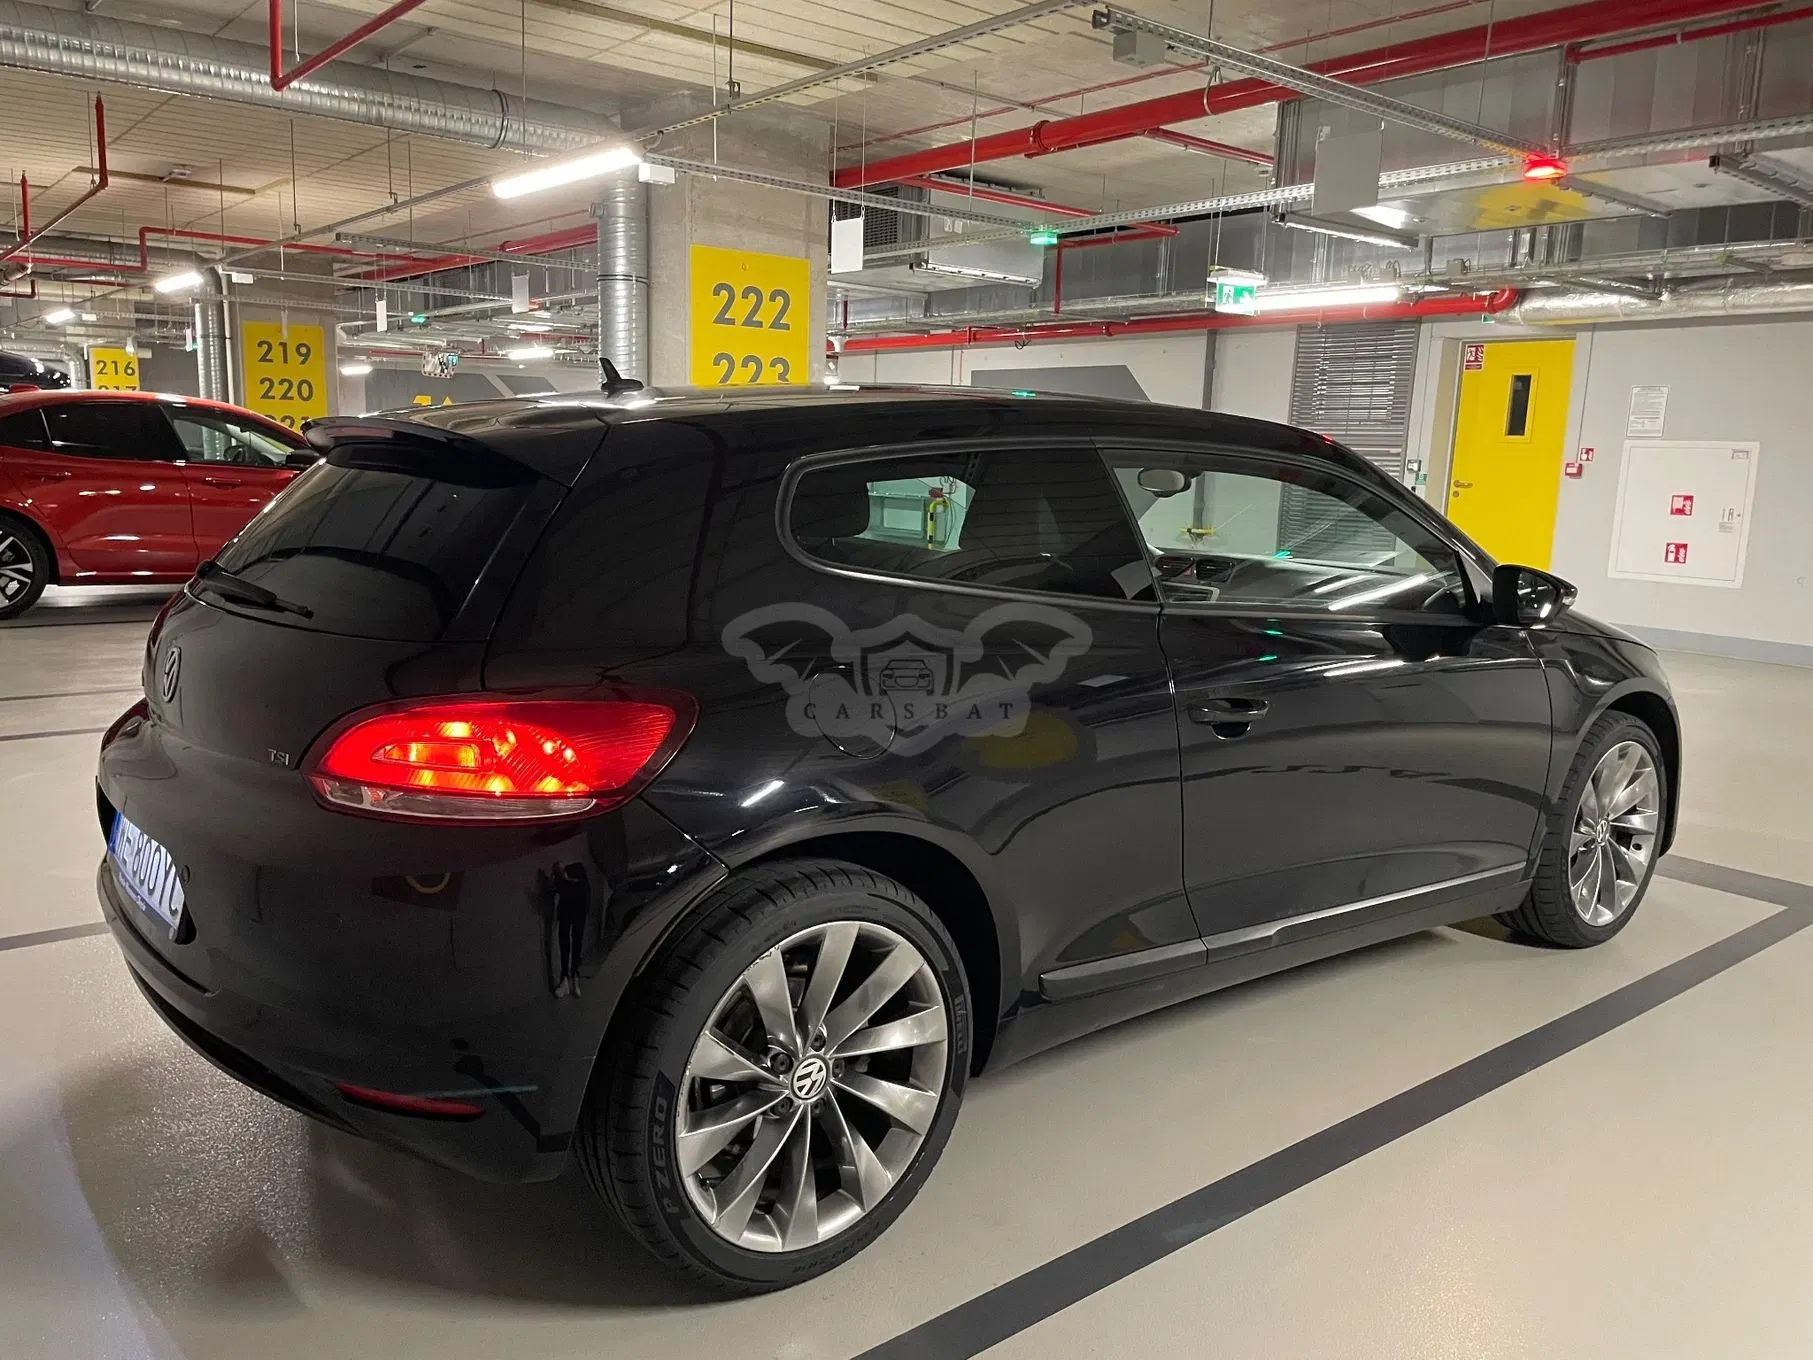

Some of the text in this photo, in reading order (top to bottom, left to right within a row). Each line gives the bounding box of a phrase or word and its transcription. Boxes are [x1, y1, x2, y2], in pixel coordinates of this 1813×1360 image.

[712, 282, 791, 331] 222
[257, 340, 312, 365] 219
[96, 360, 136, 376] 216
[260, 376, 314, 402] 220
[267, 748, 290, 766] TSI
[652, 1096, 671, 1190] ZERO
